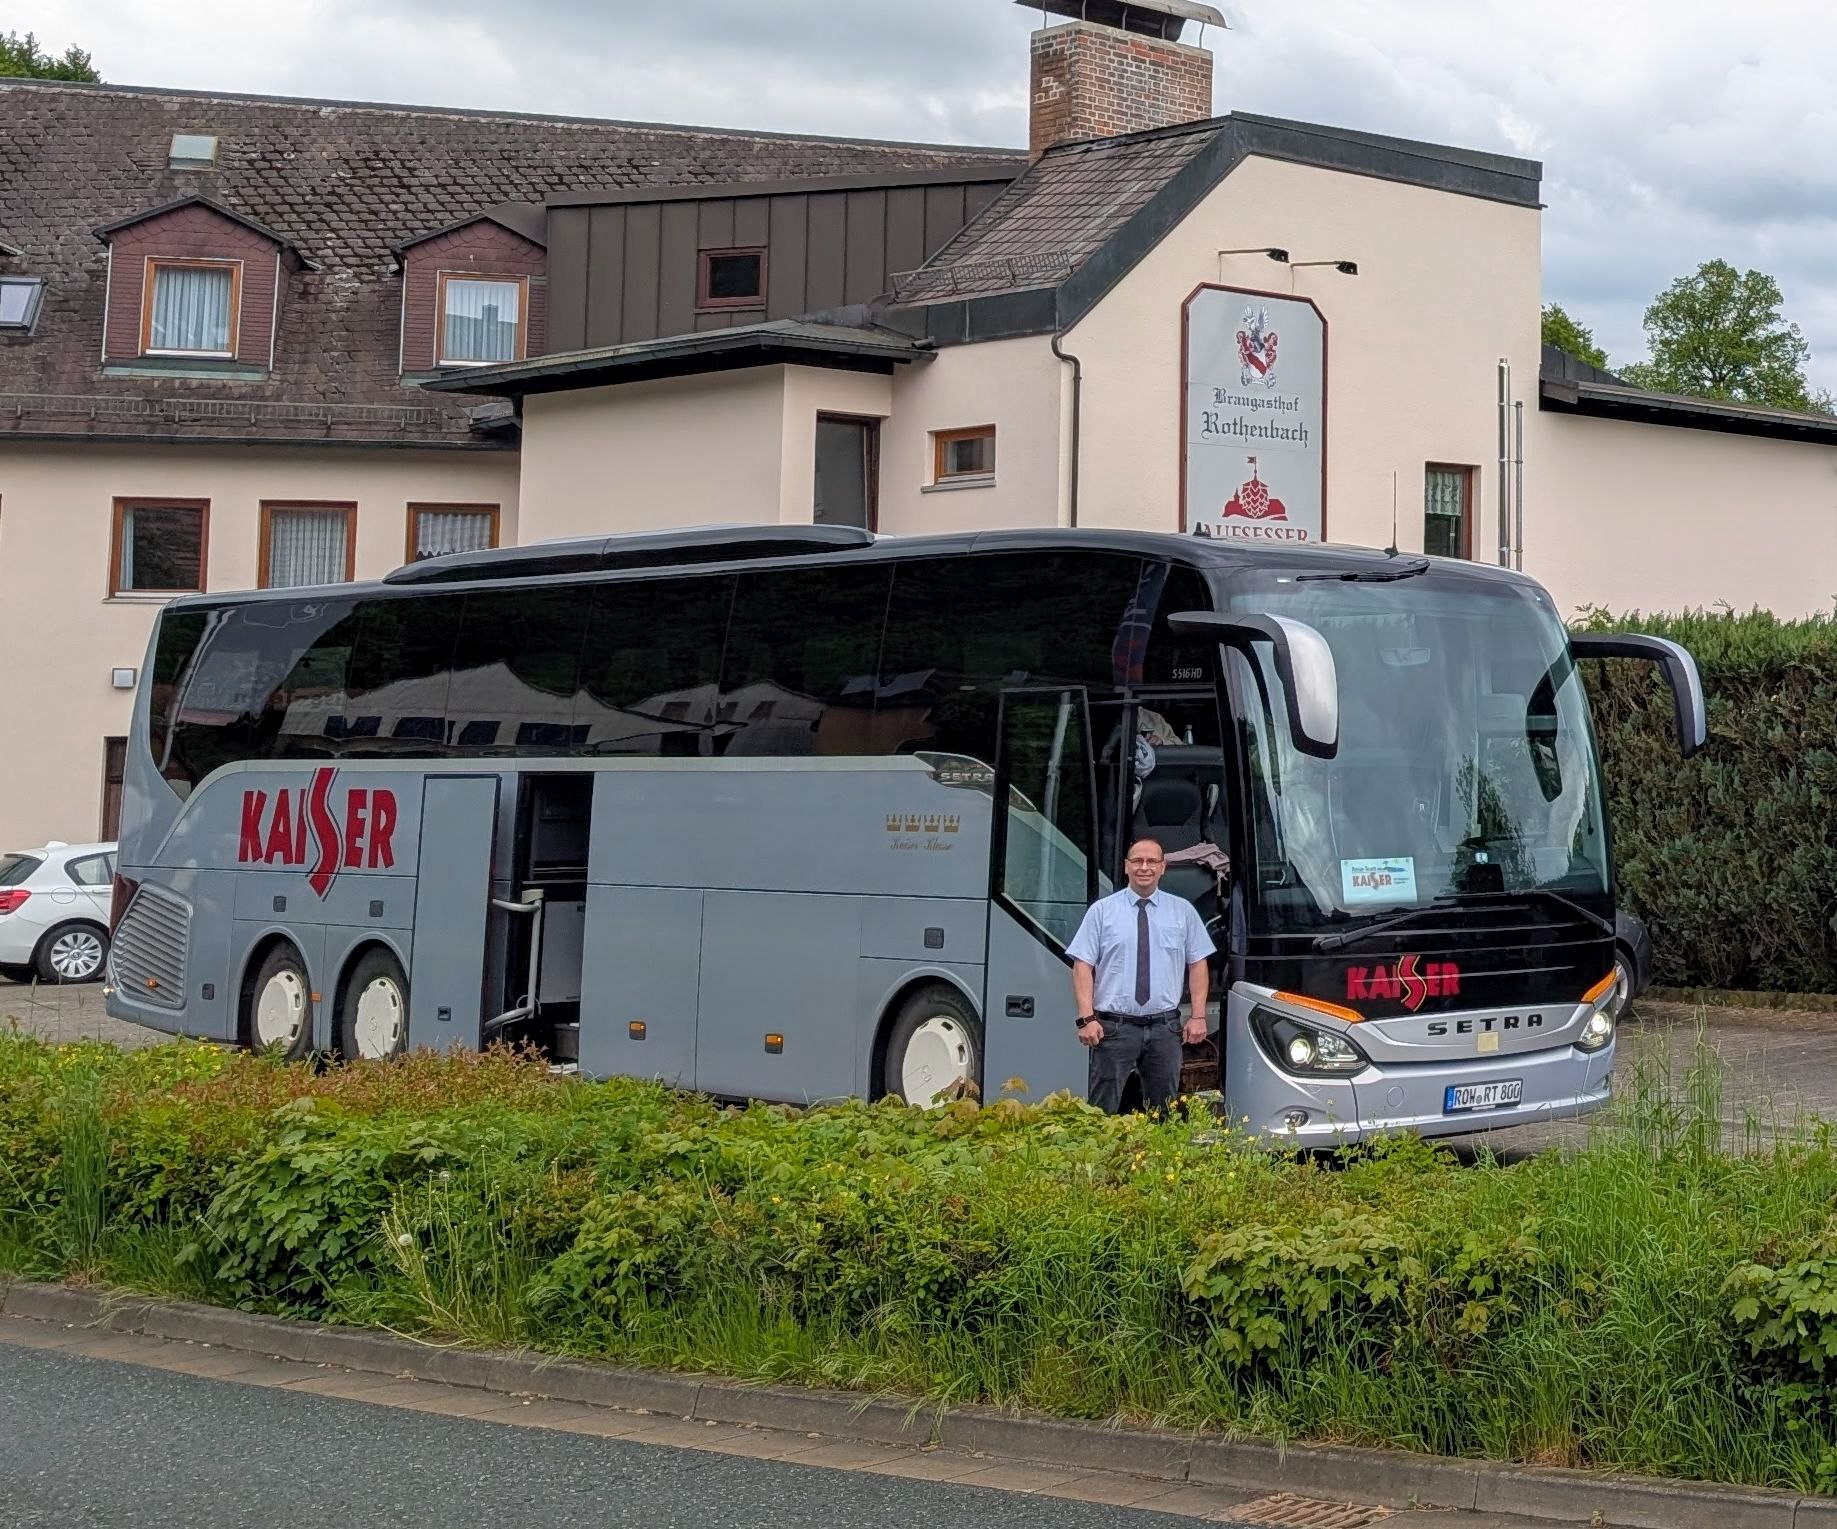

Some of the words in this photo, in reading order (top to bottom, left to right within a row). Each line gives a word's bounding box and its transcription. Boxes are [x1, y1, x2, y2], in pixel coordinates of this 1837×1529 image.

[1213, 387, 1299, 414] Braugasthof
[1201, 411, 1308, 448] Rothenbach
[238, 767, 397, 901] KAISER
[1352, 872, 1392, 890] KAISER
[1346, 953, 1461, 1013] KAISER
[1427, 1013, 1543, 1036] SETRA
[1483, 1086, 1498, 1103] RT
[1500, 1083, 1520, 1100] 800
